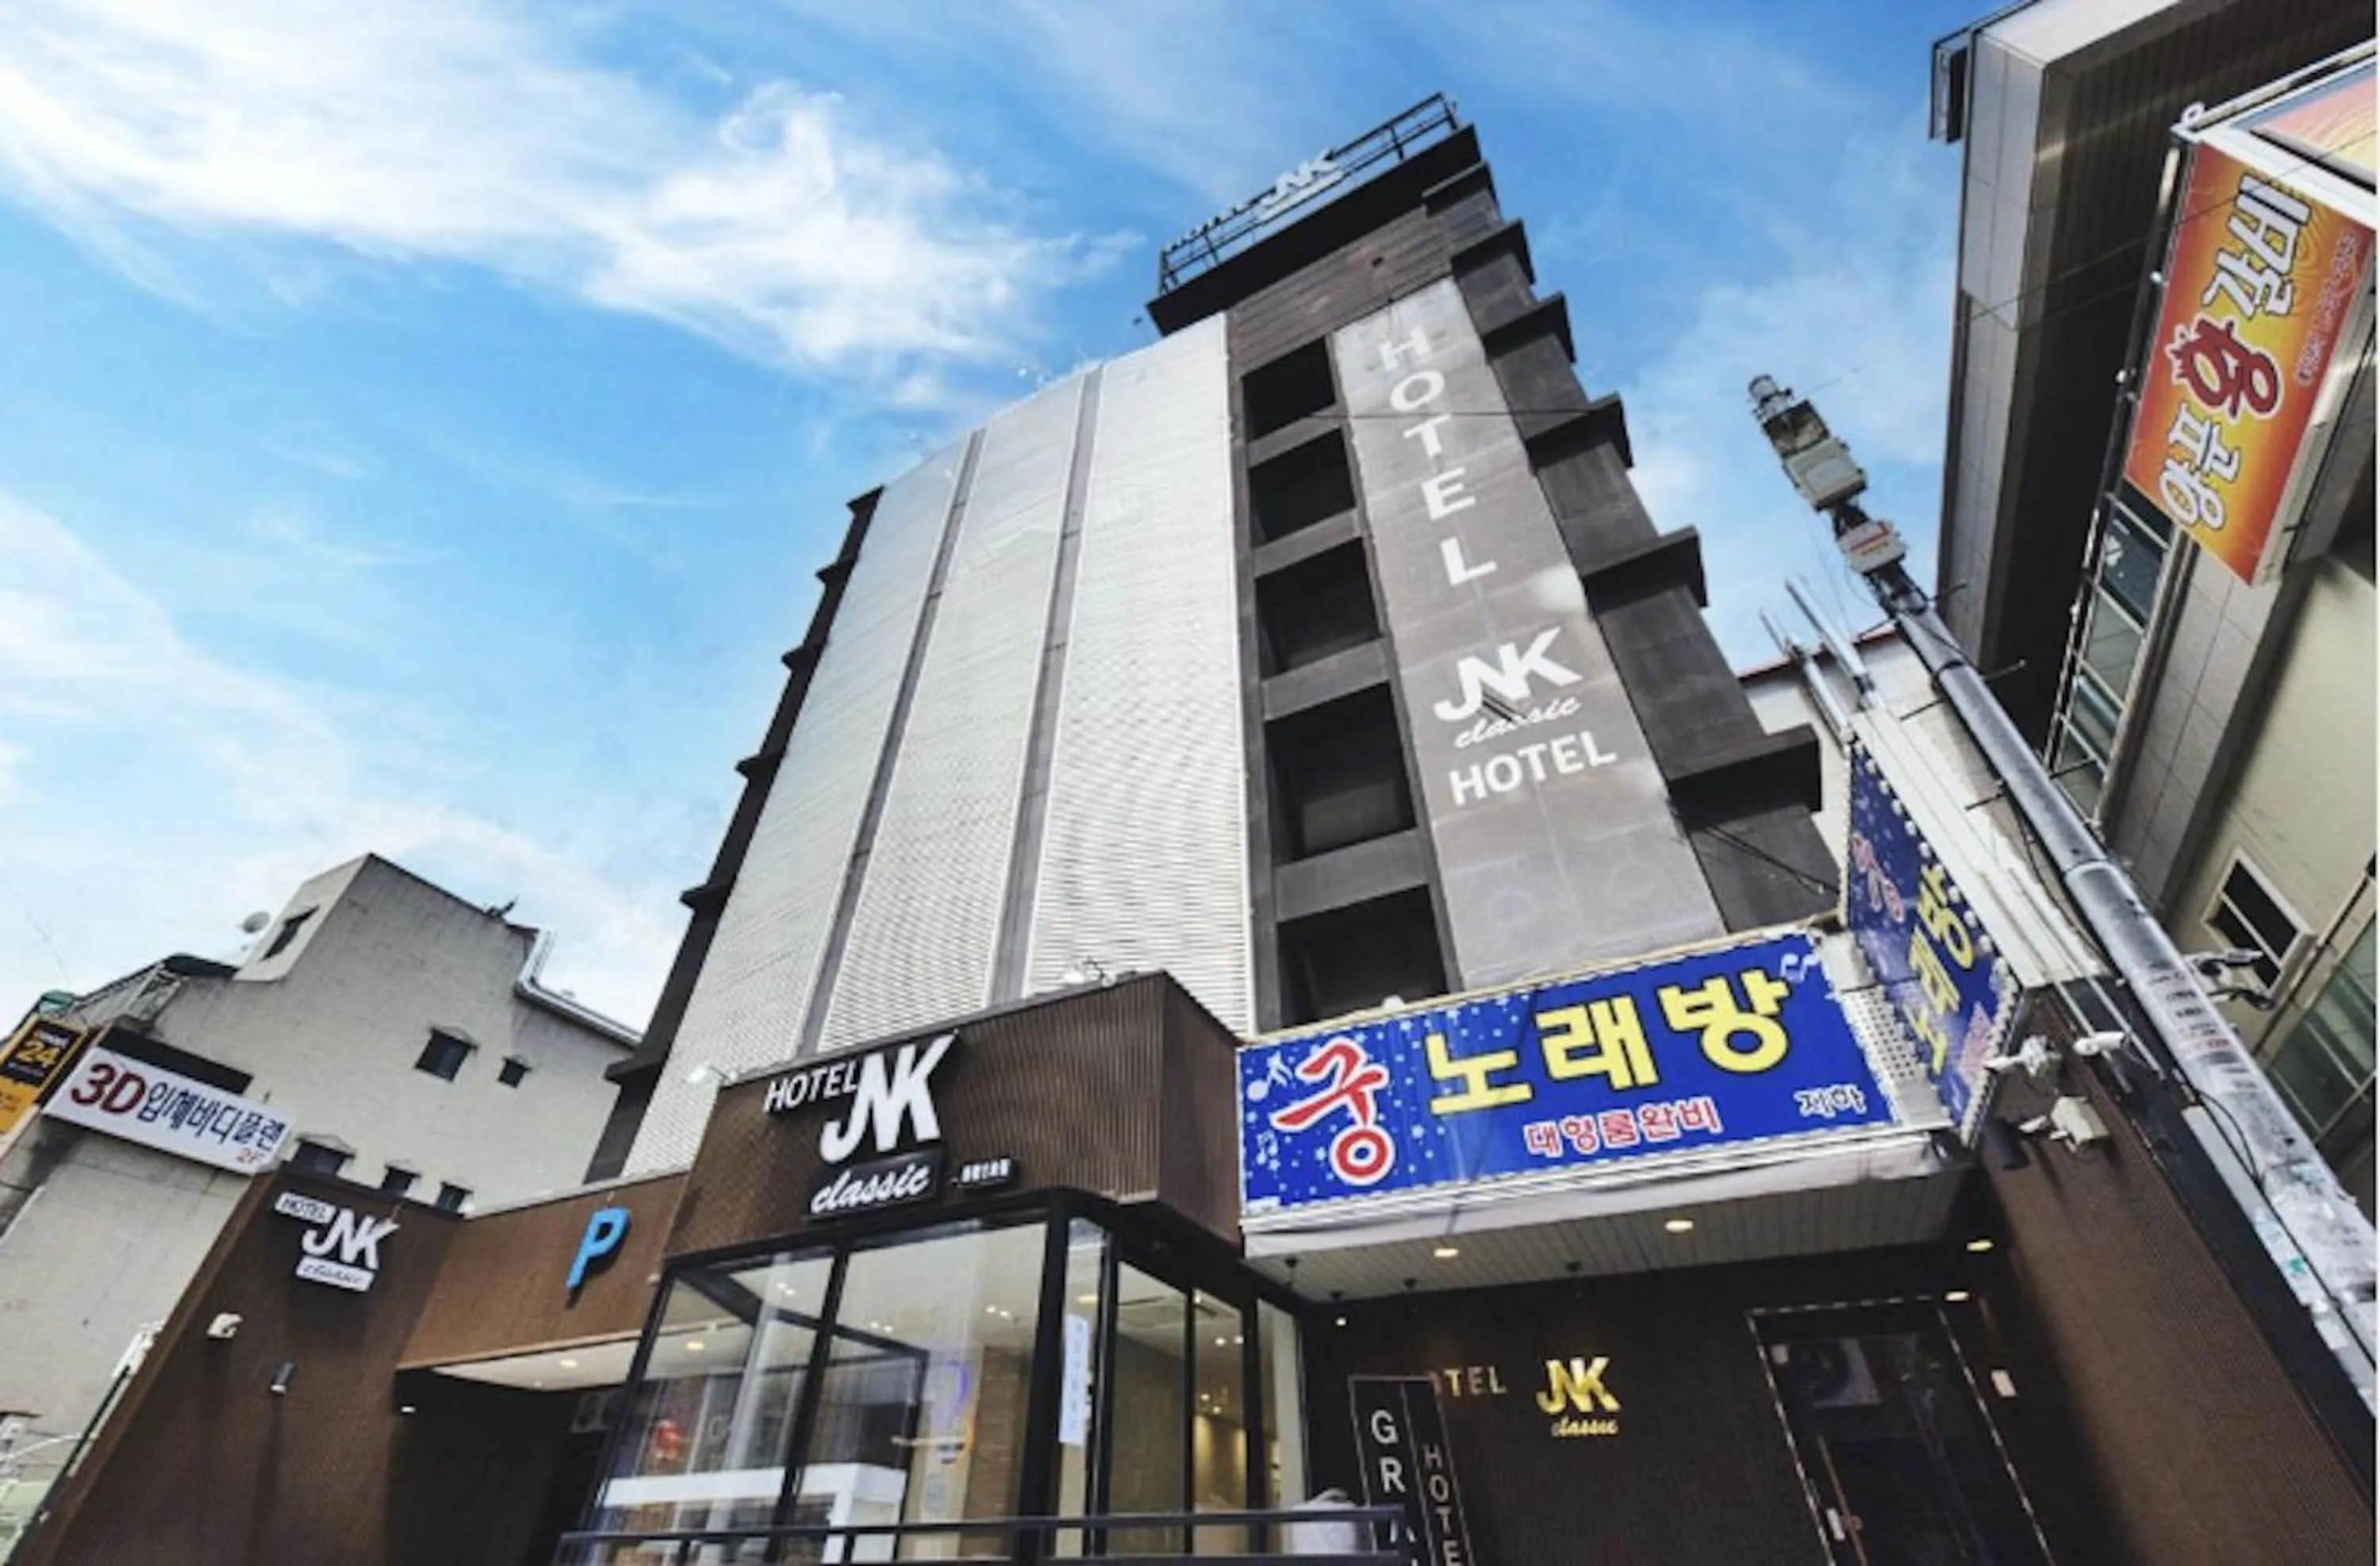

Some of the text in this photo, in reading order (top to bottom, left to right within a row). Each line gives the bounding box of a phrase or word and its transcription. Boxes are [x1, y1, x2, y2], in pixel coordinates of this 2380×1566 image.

[1380, 324, 1498, 585] HOTEL
[1433, 626, 1584, 722] JNK
[1449, 730, 1618, 806] HOTEL
[1426, 969, 1791, 1115] 노래방
[71, 1062, 147, 1115] 3D
[762, 1031, 956, 1164] HOTEL JNK
[809, 1162, 931, 1215] classic
[301, 1207, 401, 1270] JNK
[565, 1207, 629, 1288] P
[1535, 1356, 1622, 1414] JNK
